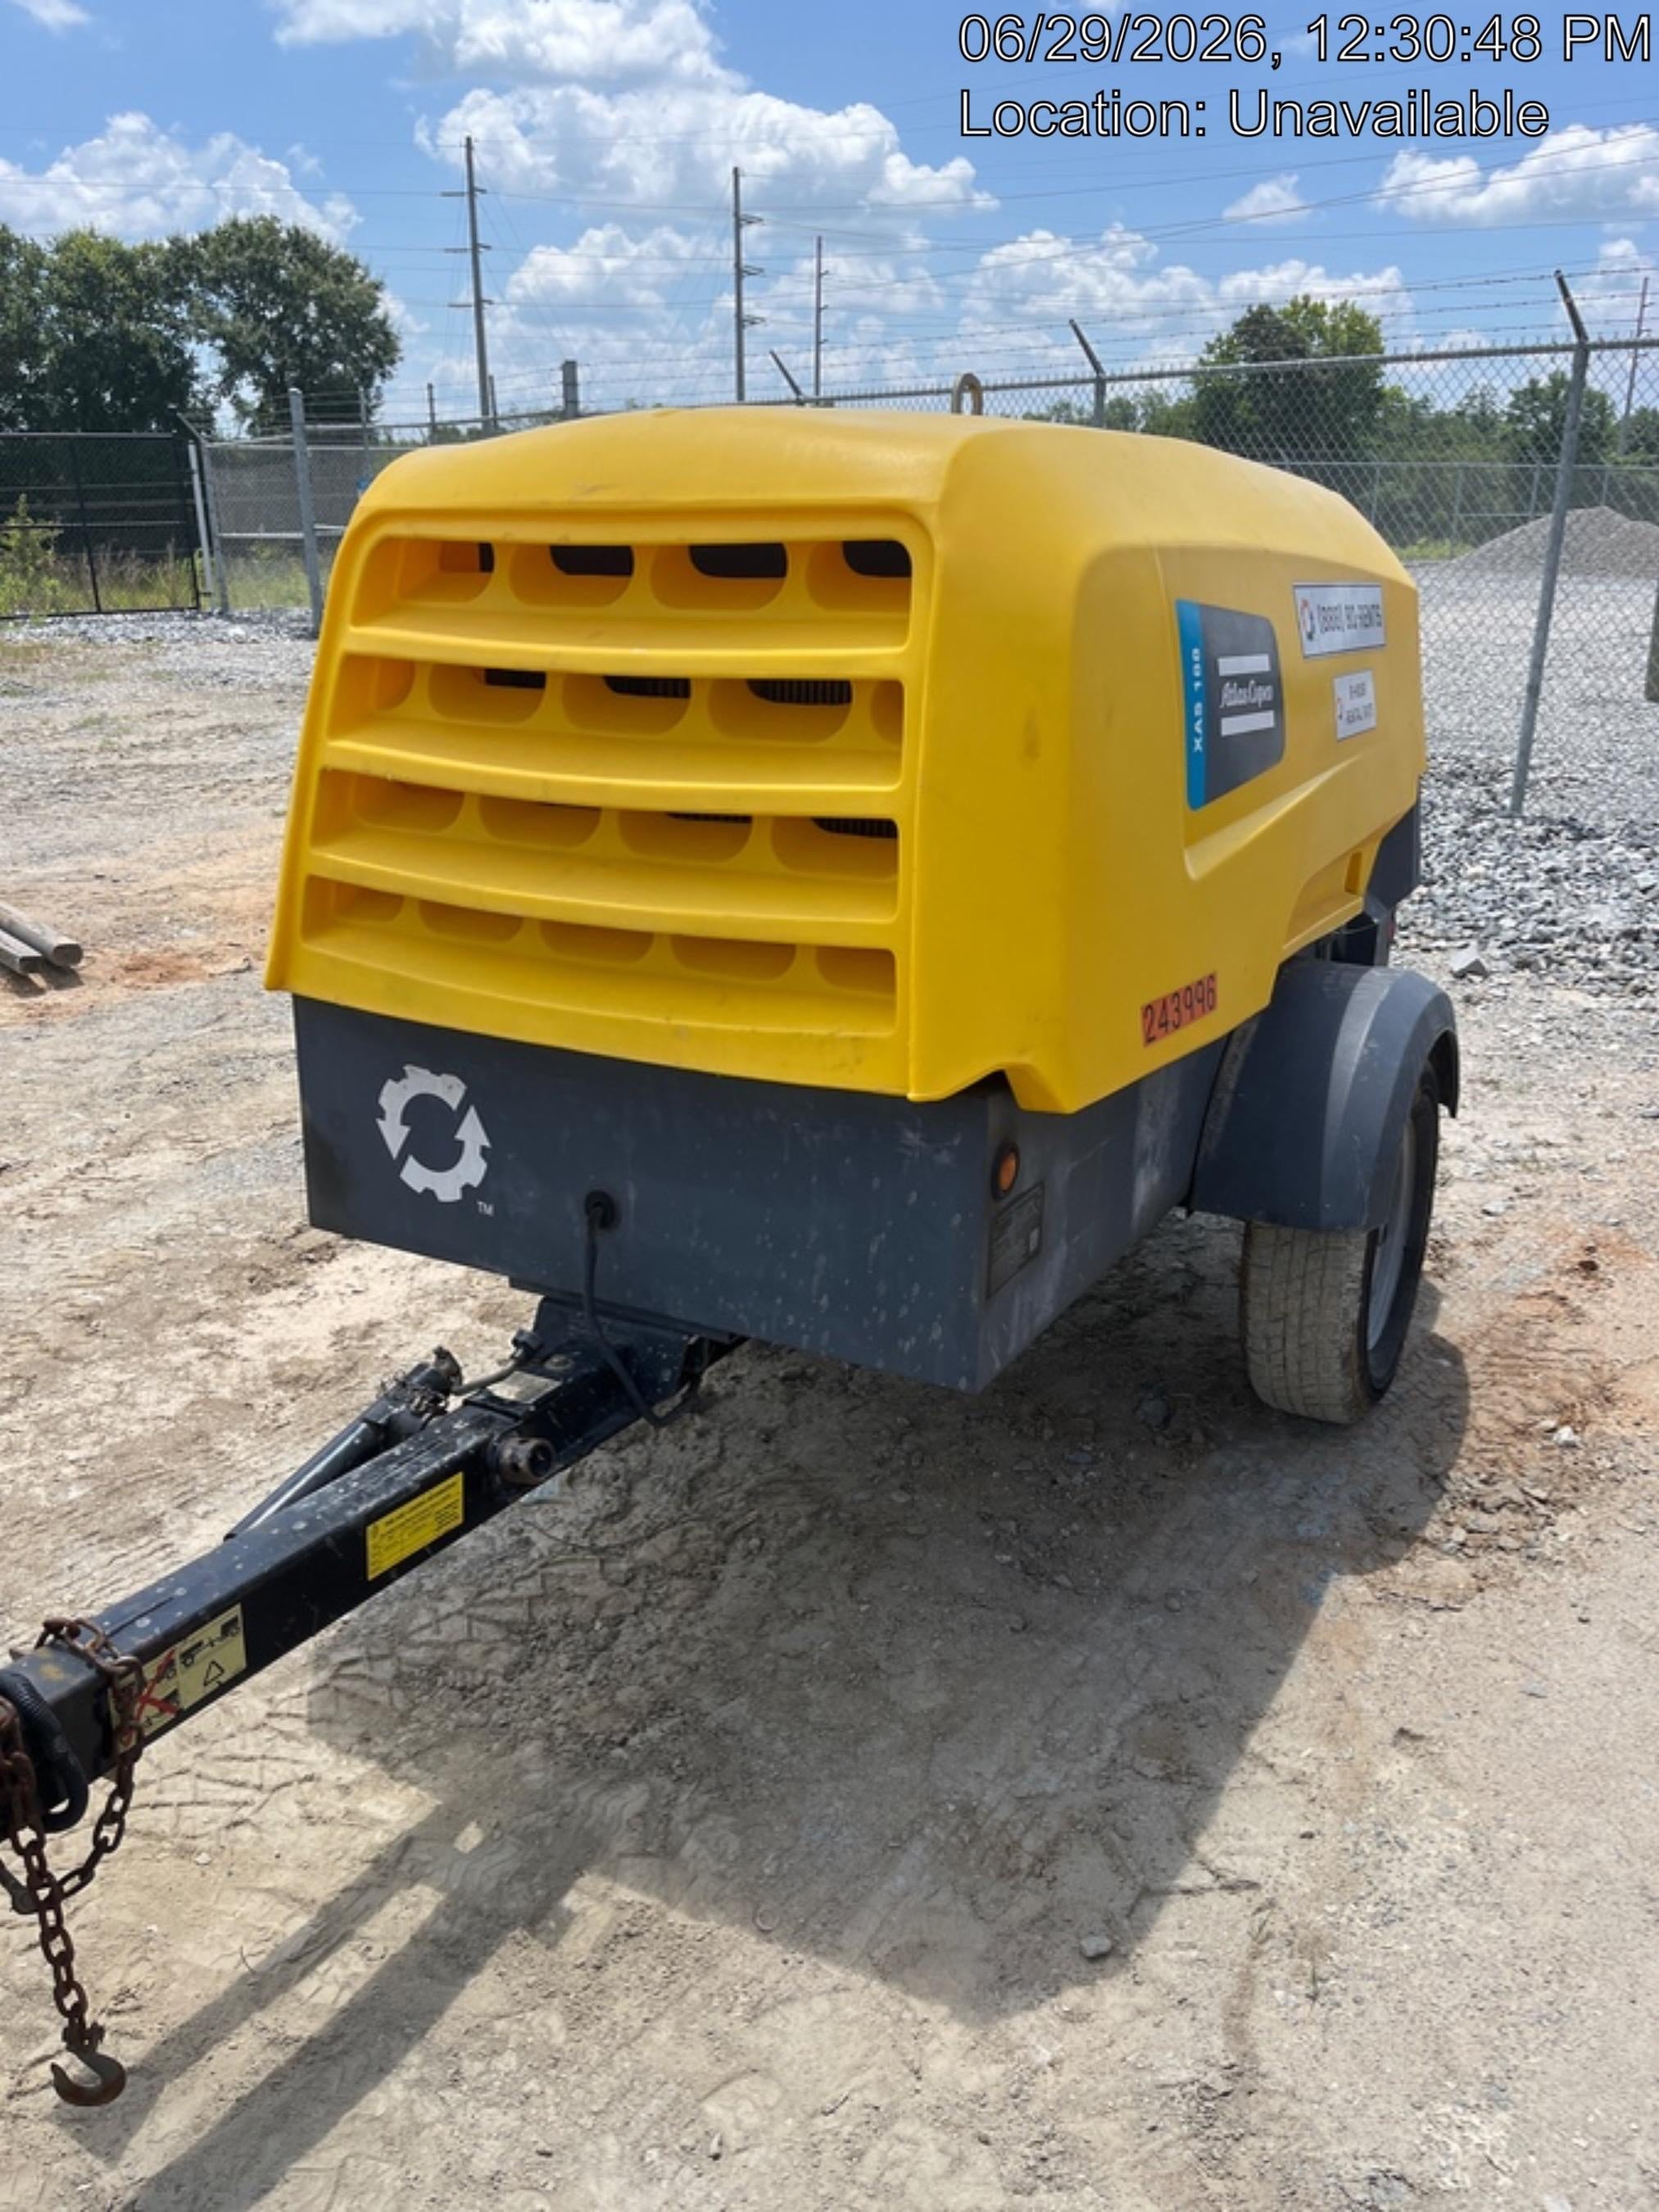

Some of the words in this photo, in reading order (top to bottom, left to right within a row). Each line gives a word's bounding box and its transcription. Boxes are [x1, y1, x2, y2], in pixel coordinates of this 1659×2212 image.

[1219, 682, 1247, 708] Atlas
[1247, 679, 1274, 708] Copco
[1144, 972, 1216, 1044] 243996
[477, 1200, 494, 1217] TM
